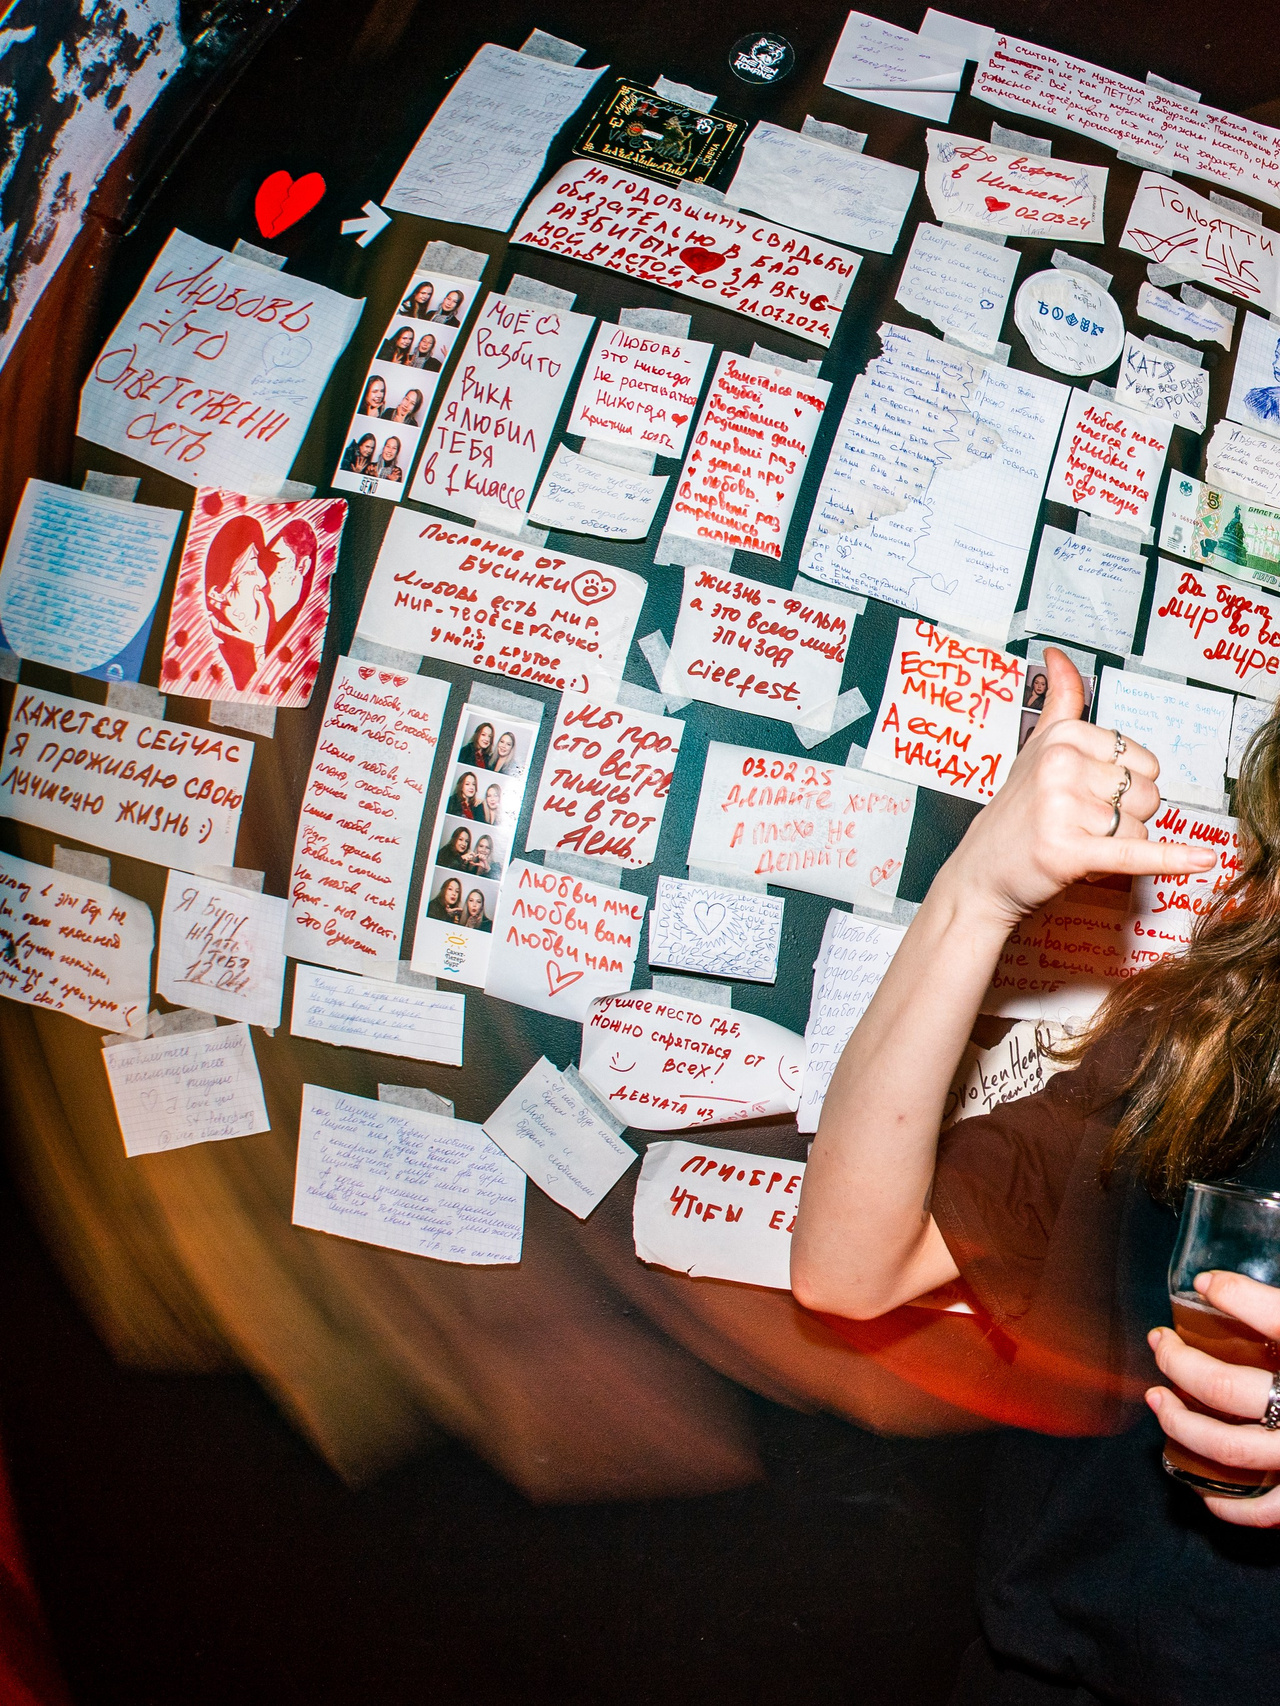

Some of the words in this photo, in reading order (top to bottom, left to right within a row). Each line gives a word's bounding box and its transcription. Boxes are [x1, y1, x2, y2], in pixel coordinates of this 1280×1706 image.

[751, 256, 799, 277] БАР
[753, 229, 853, 277] СВАДЬБЫ
[1207, 491, 1220, 510] 5
[1248, 506, 1272, 518] БИЛЕТ
[137, 726, 240, 763] СЕЙЧАС
